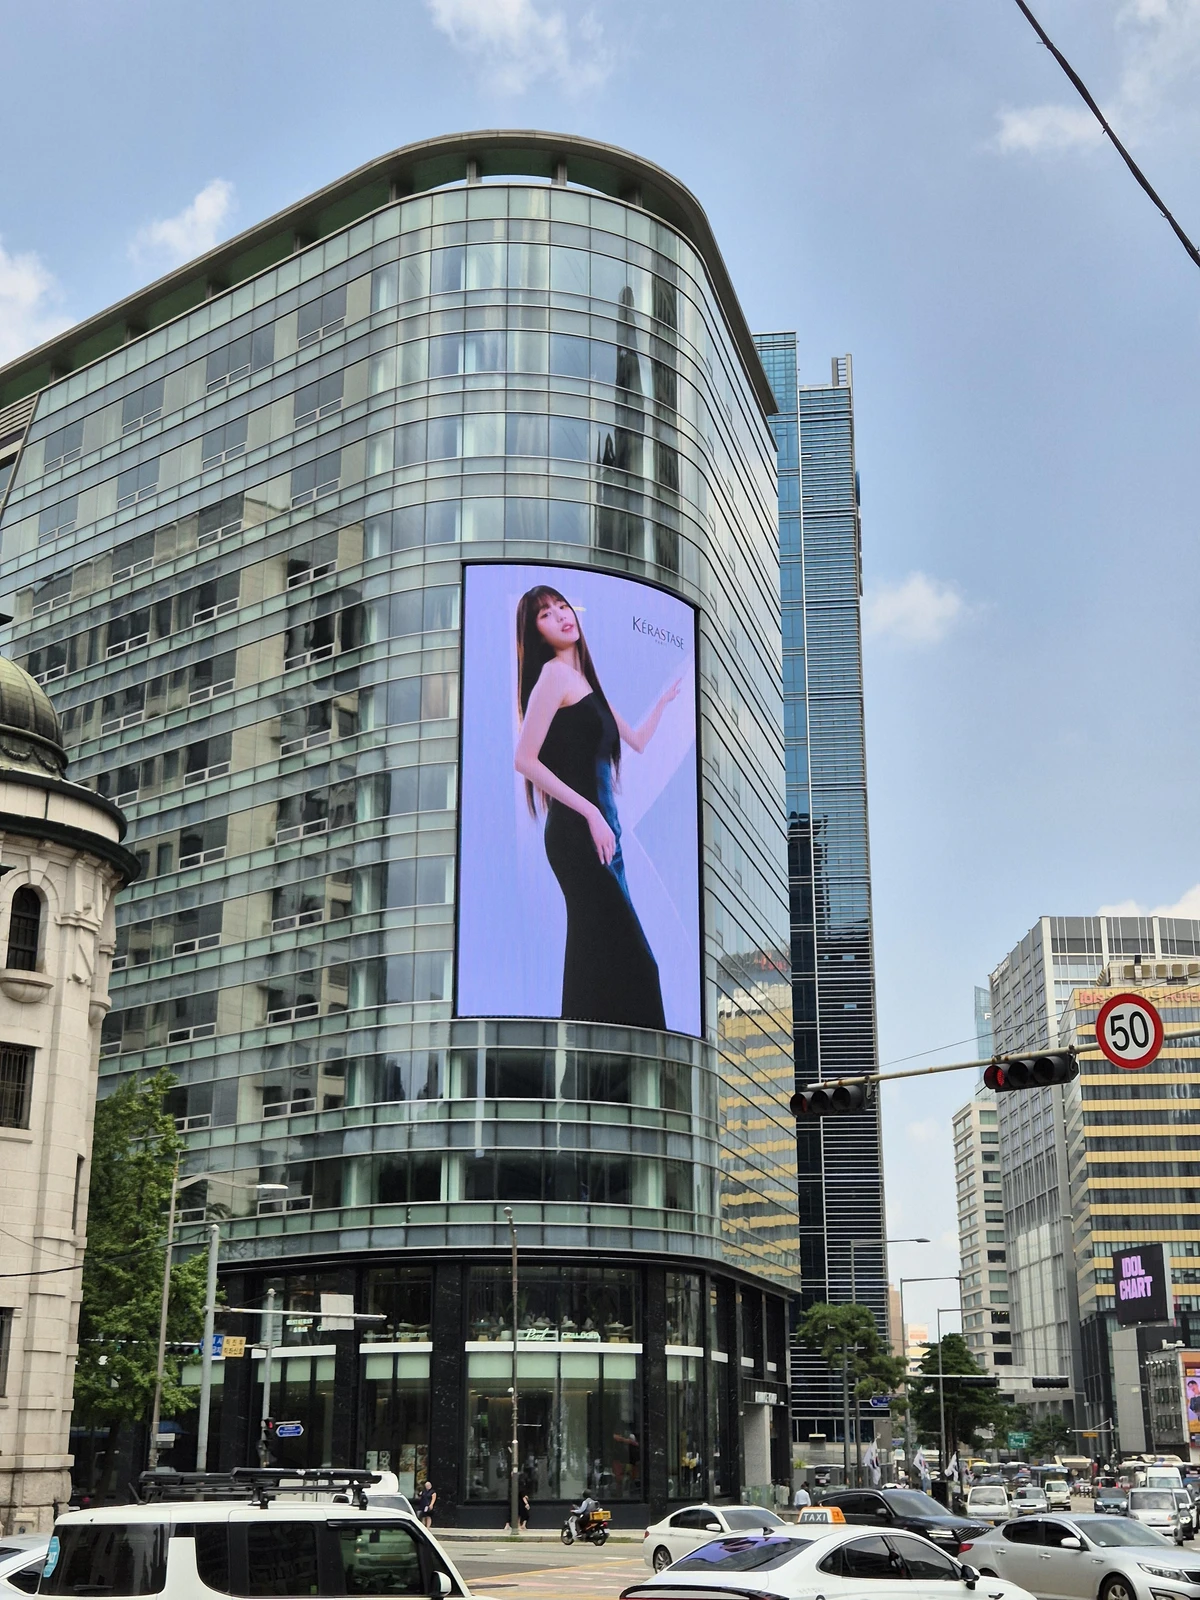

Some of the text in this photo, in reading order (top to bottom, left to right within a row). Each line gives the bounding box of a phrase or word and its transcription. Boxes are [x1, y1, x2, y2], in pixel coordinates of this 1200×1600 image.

[632, 616, 684, 650] KÉRASTASE
[1110, 1011, 1149, 1051] 50
[1122, 1255, 1145, 1278] IDOL
[1119, 1276, 1153, 1301] CHART
[803, 1513, 827, 1522] TAXI
